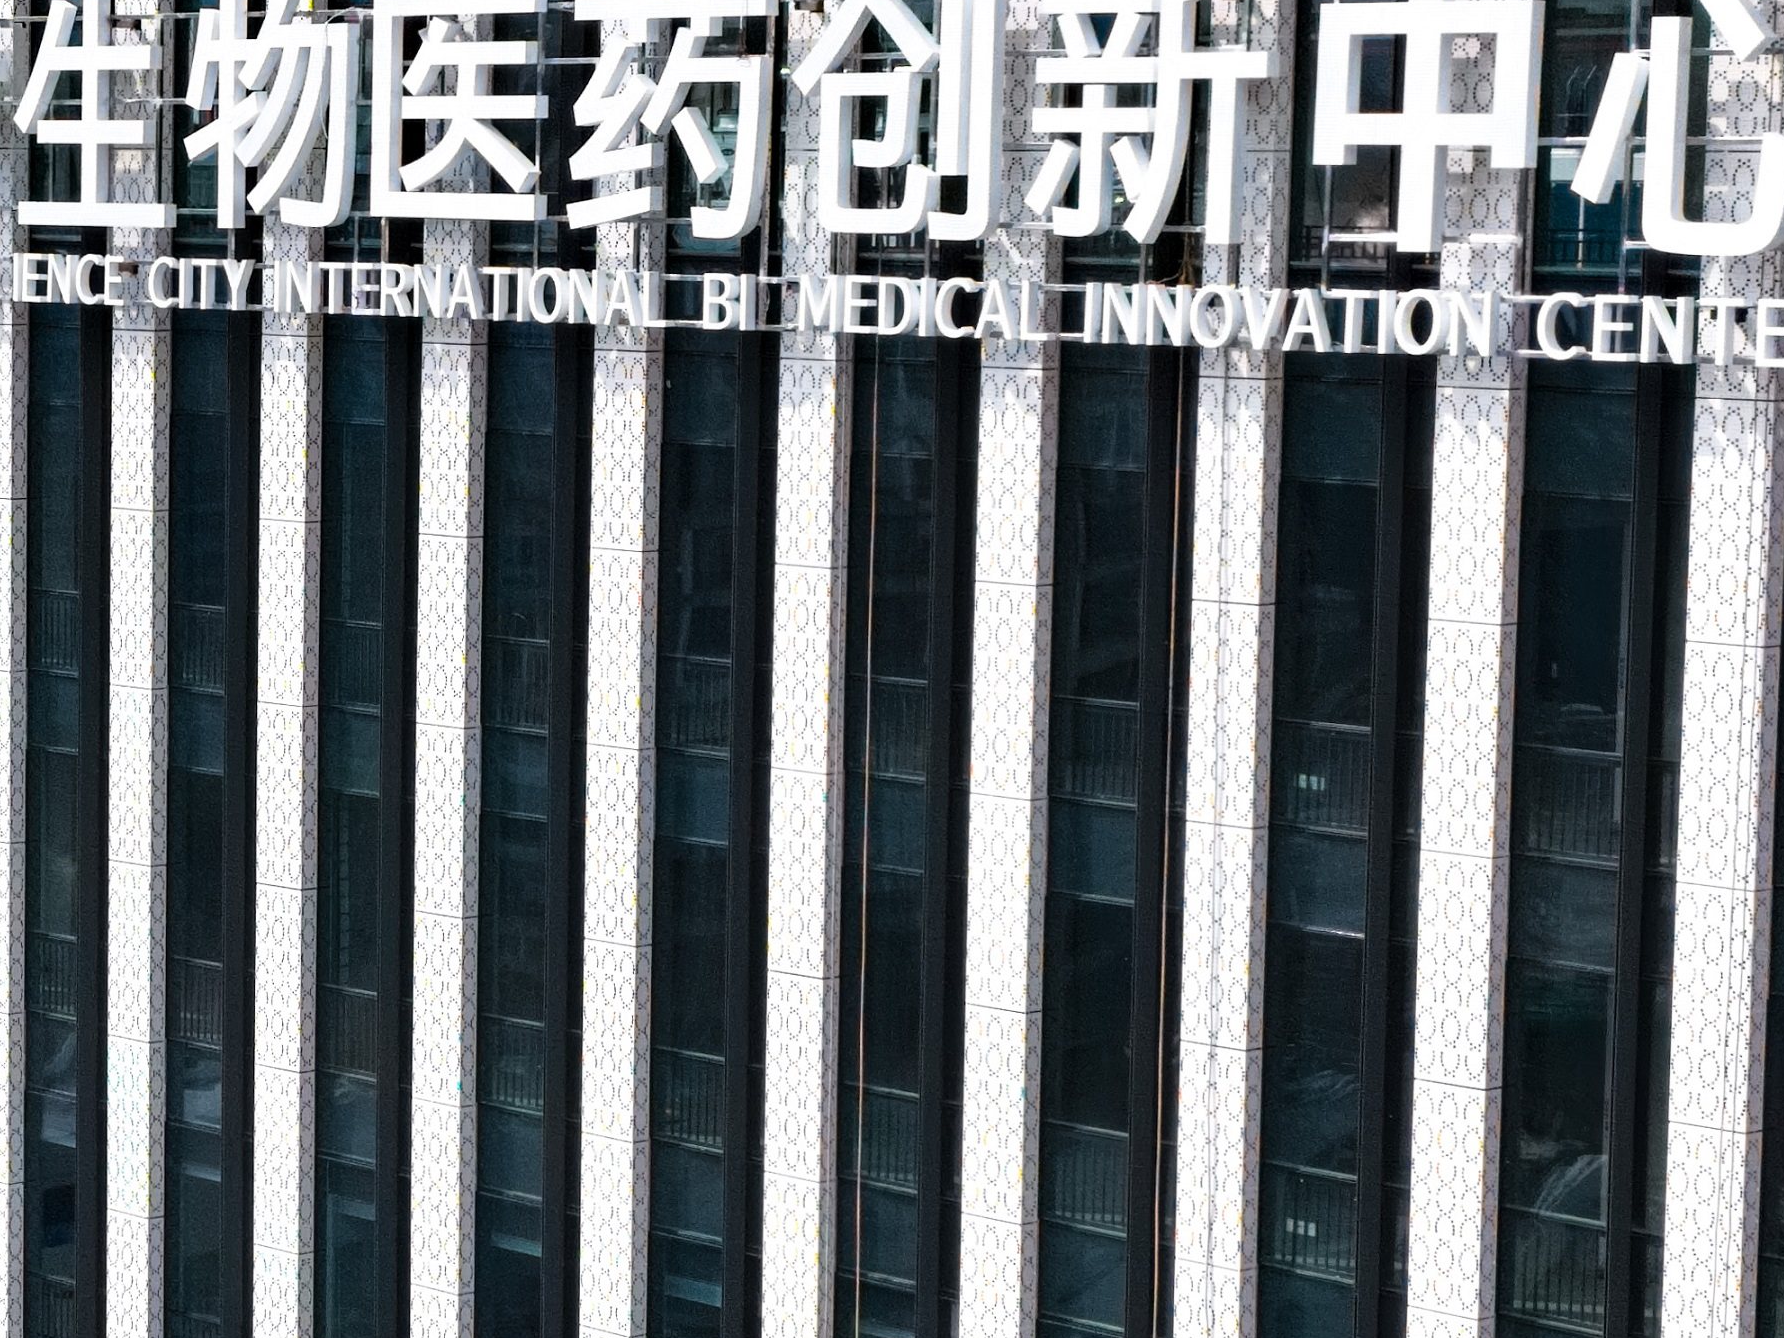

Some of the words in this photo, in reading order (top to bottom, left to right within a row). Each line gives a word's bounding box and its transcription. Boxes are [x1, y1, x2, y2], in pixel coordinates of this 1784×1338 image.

[148, 256, 255, 310] CITY
[273, 260, 666, 329] INTERNATIONAL
[1083, 281, 1500, 356] INNOVATION
